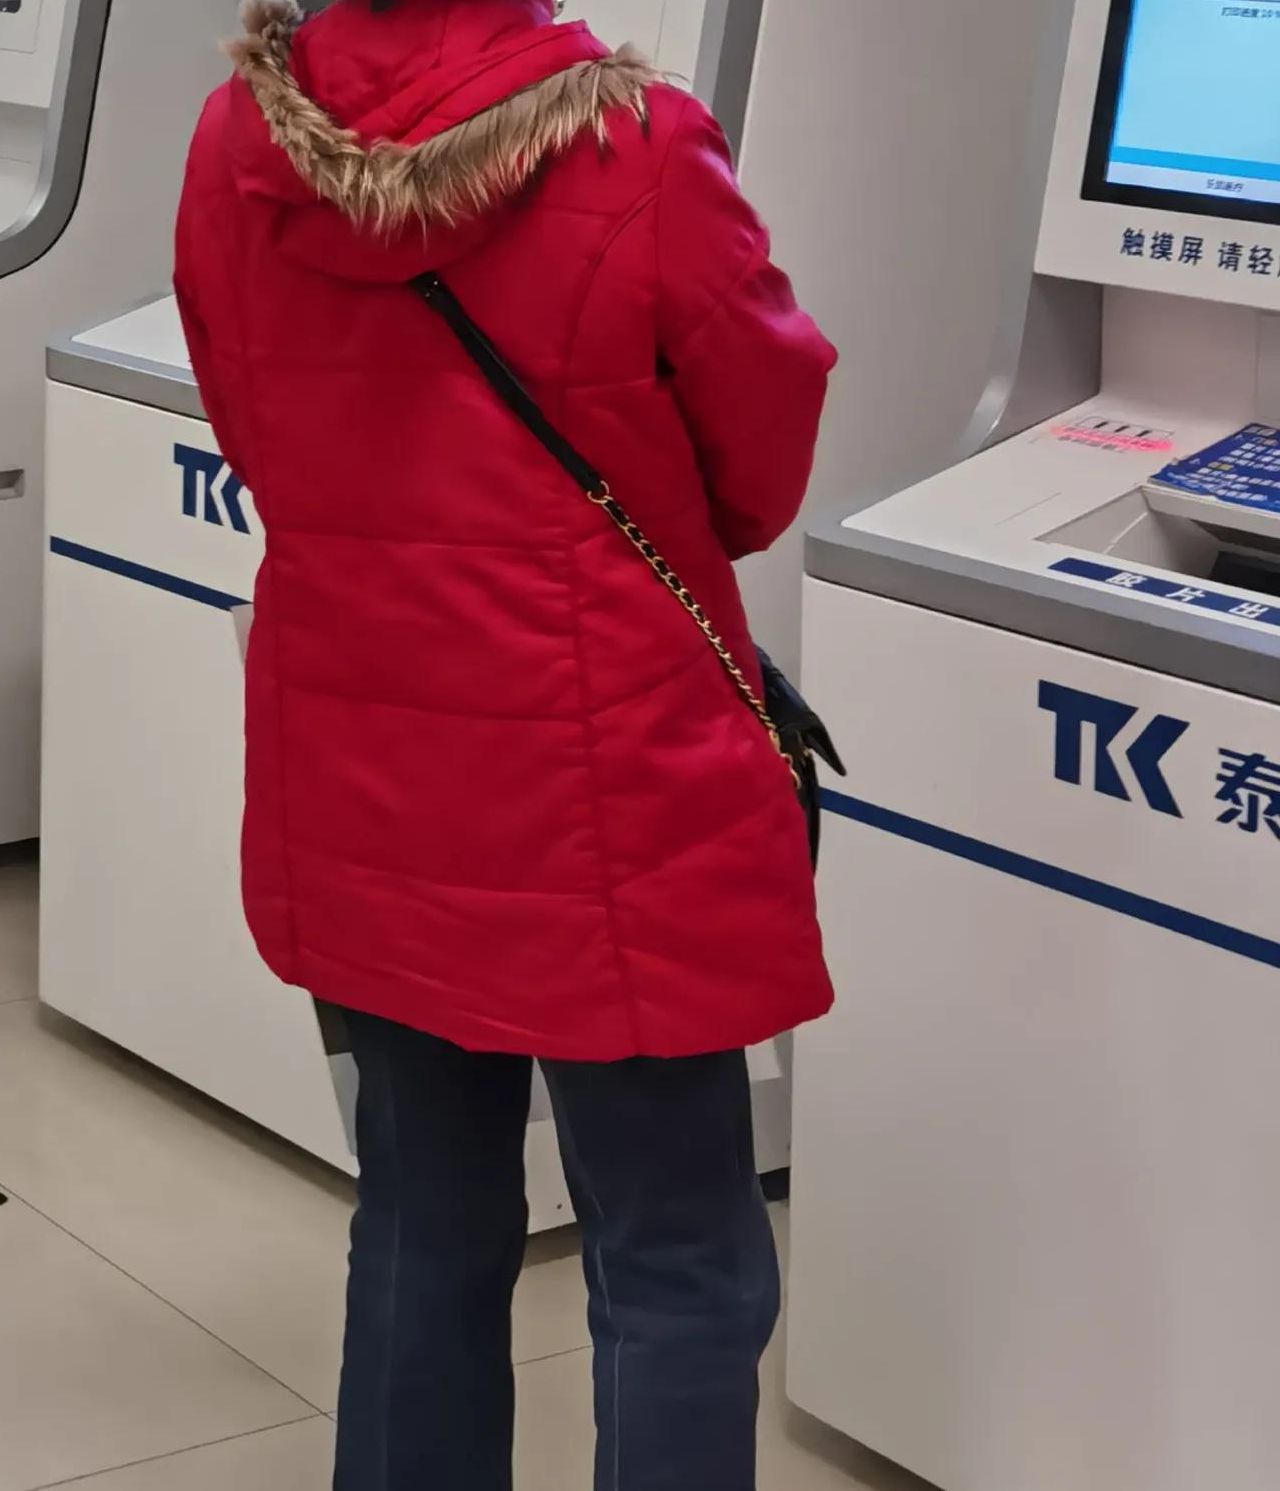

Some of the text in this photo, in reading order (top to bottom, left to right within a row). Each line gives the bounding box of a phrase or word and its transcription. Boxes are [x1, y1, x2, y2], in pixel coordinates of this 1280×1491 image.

[1120, 227, 1280, 278] 触摸屏 请轻
